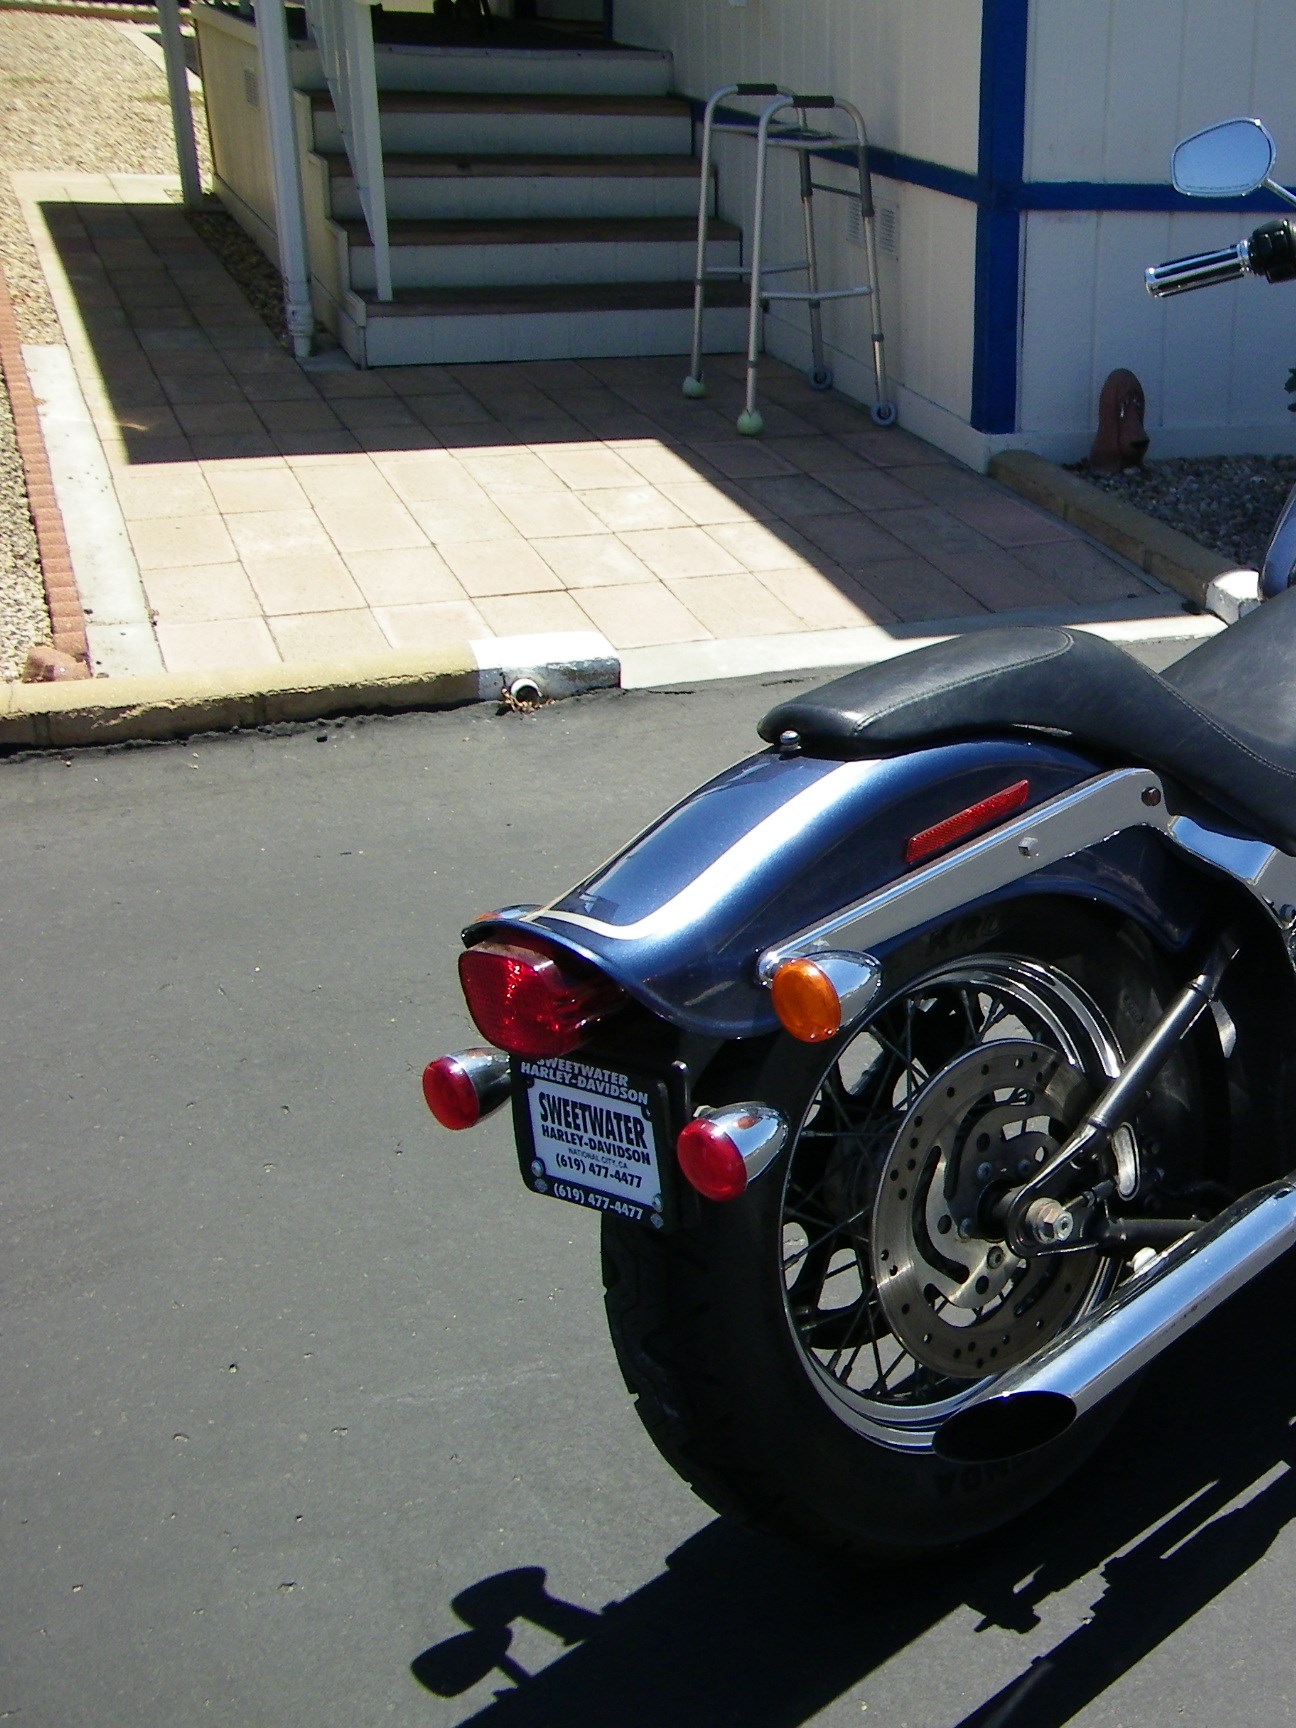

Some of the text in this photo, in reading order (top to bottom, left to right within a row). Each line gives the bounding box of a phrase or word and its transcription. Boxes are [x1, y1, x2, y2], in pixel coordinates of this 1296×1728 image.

[520, 1061, 649, 1105] HARLEY-DAVIDSON
[538, 1091, 648, 1150] SWEETWATER
[541, 1123, 652, 1165] HARLEY-DAVIDSON
[568, 1148, 600, 1162] NATIONAL
[555, 1153, 643, 1188] (619) 477-4477
[553, 1183, 644, 1220] (619) 477-4477
